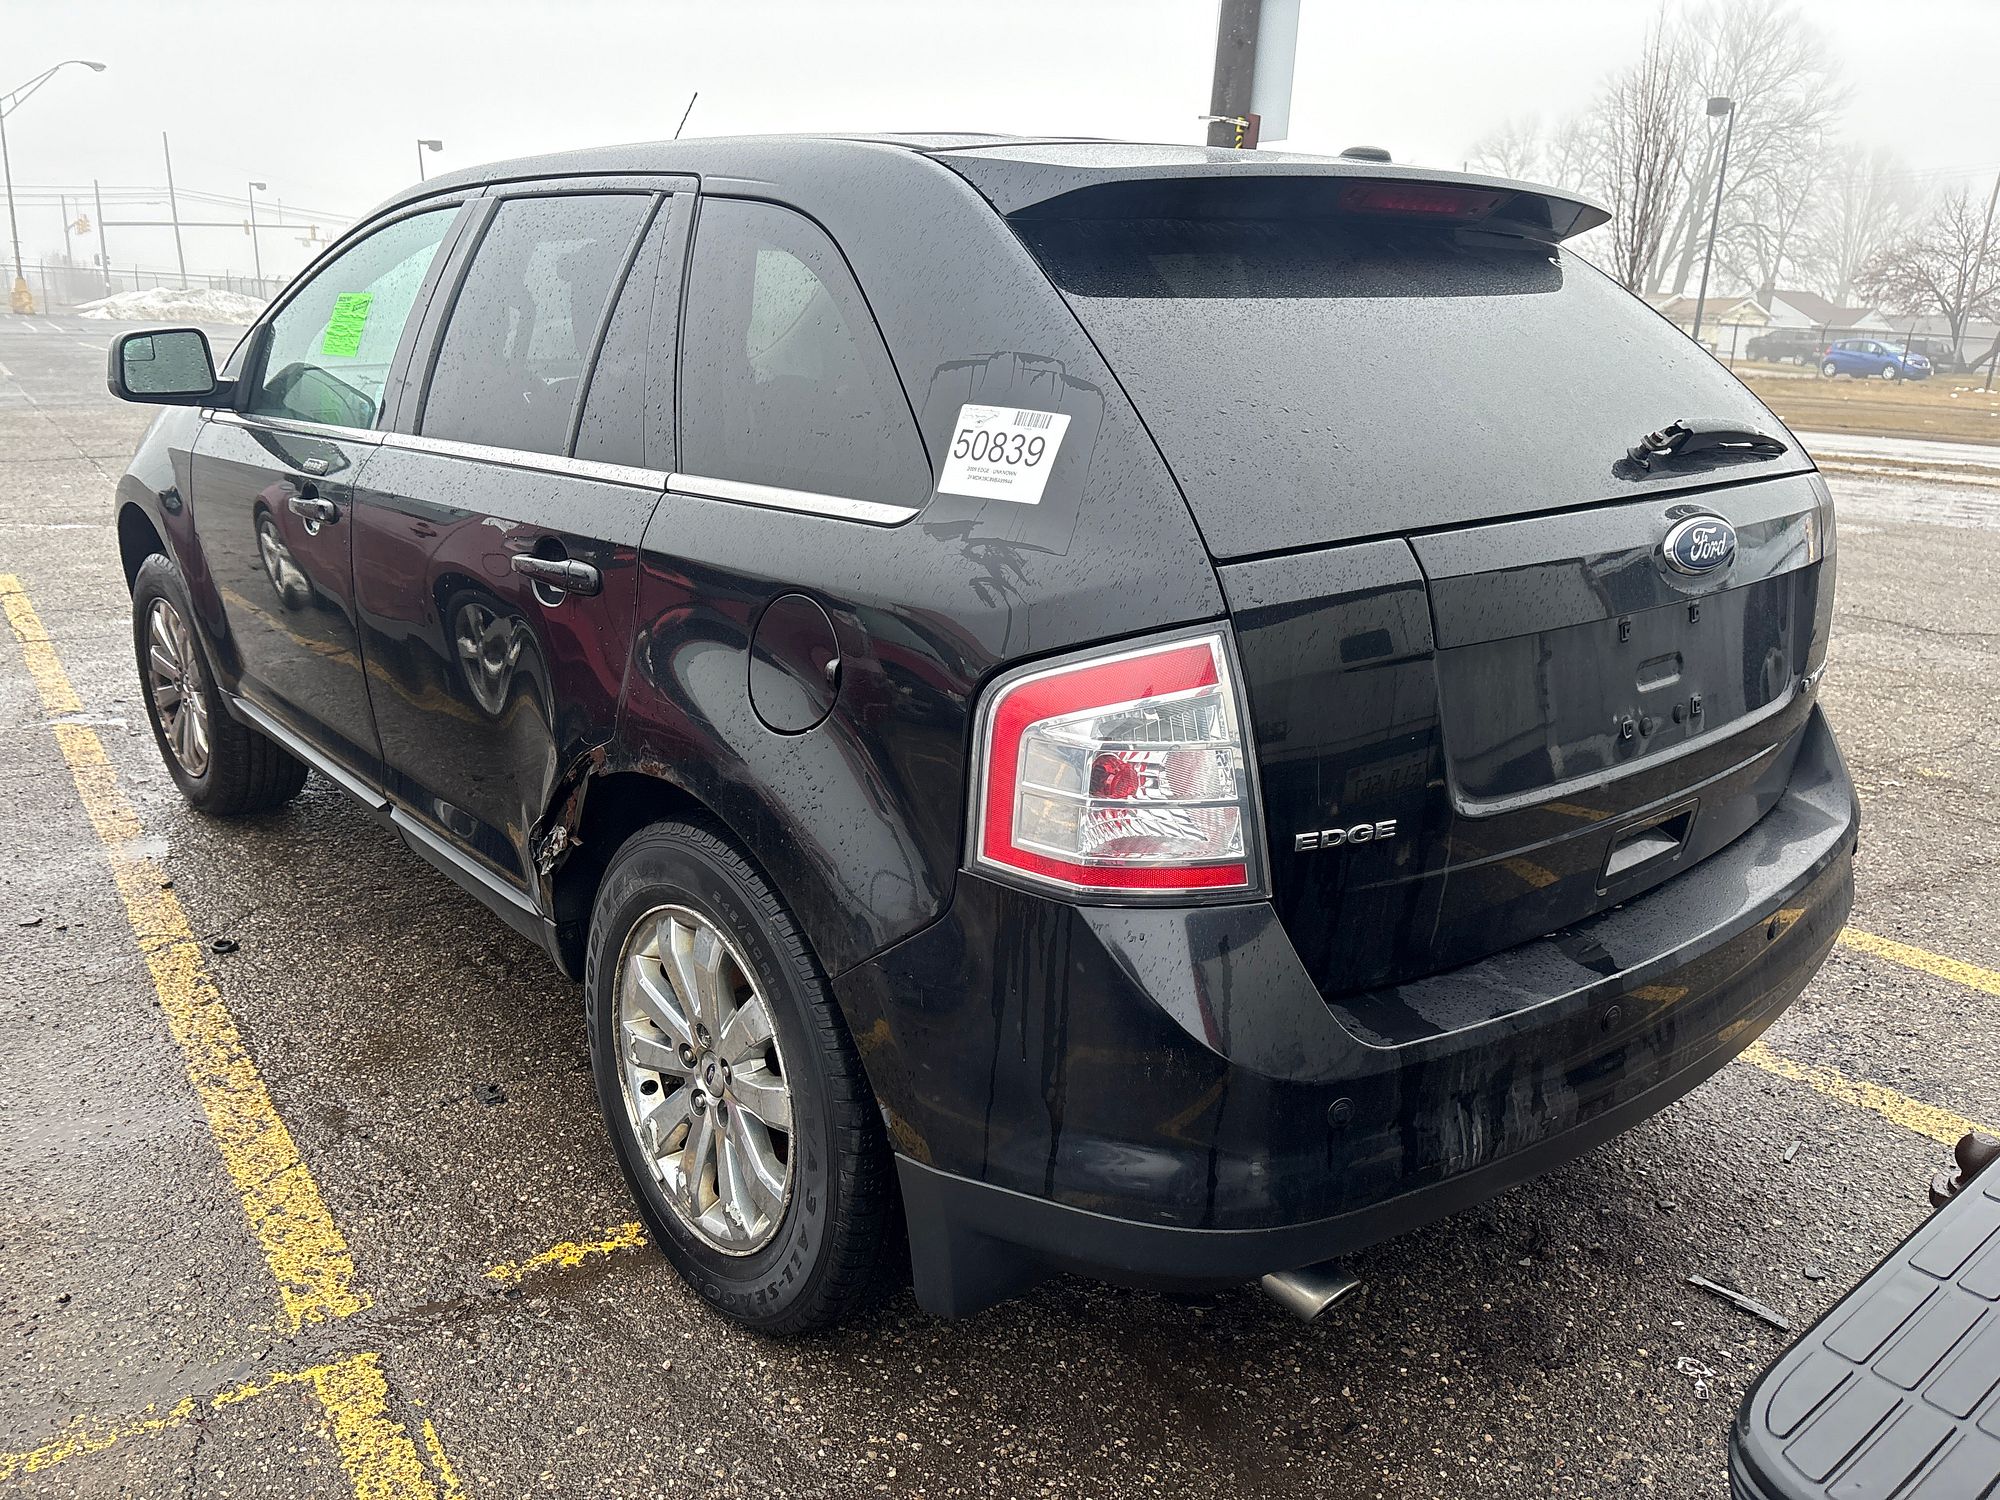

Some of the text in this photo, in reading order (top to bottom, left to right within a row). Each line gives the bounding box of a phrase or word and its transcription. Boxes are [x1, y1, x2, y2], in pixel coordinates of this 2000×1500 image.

[953, 429, 1046, 466] 50839
[1689, 527, 1727, 561] Ford
[1294, 819, 1397, 852] EDGE
